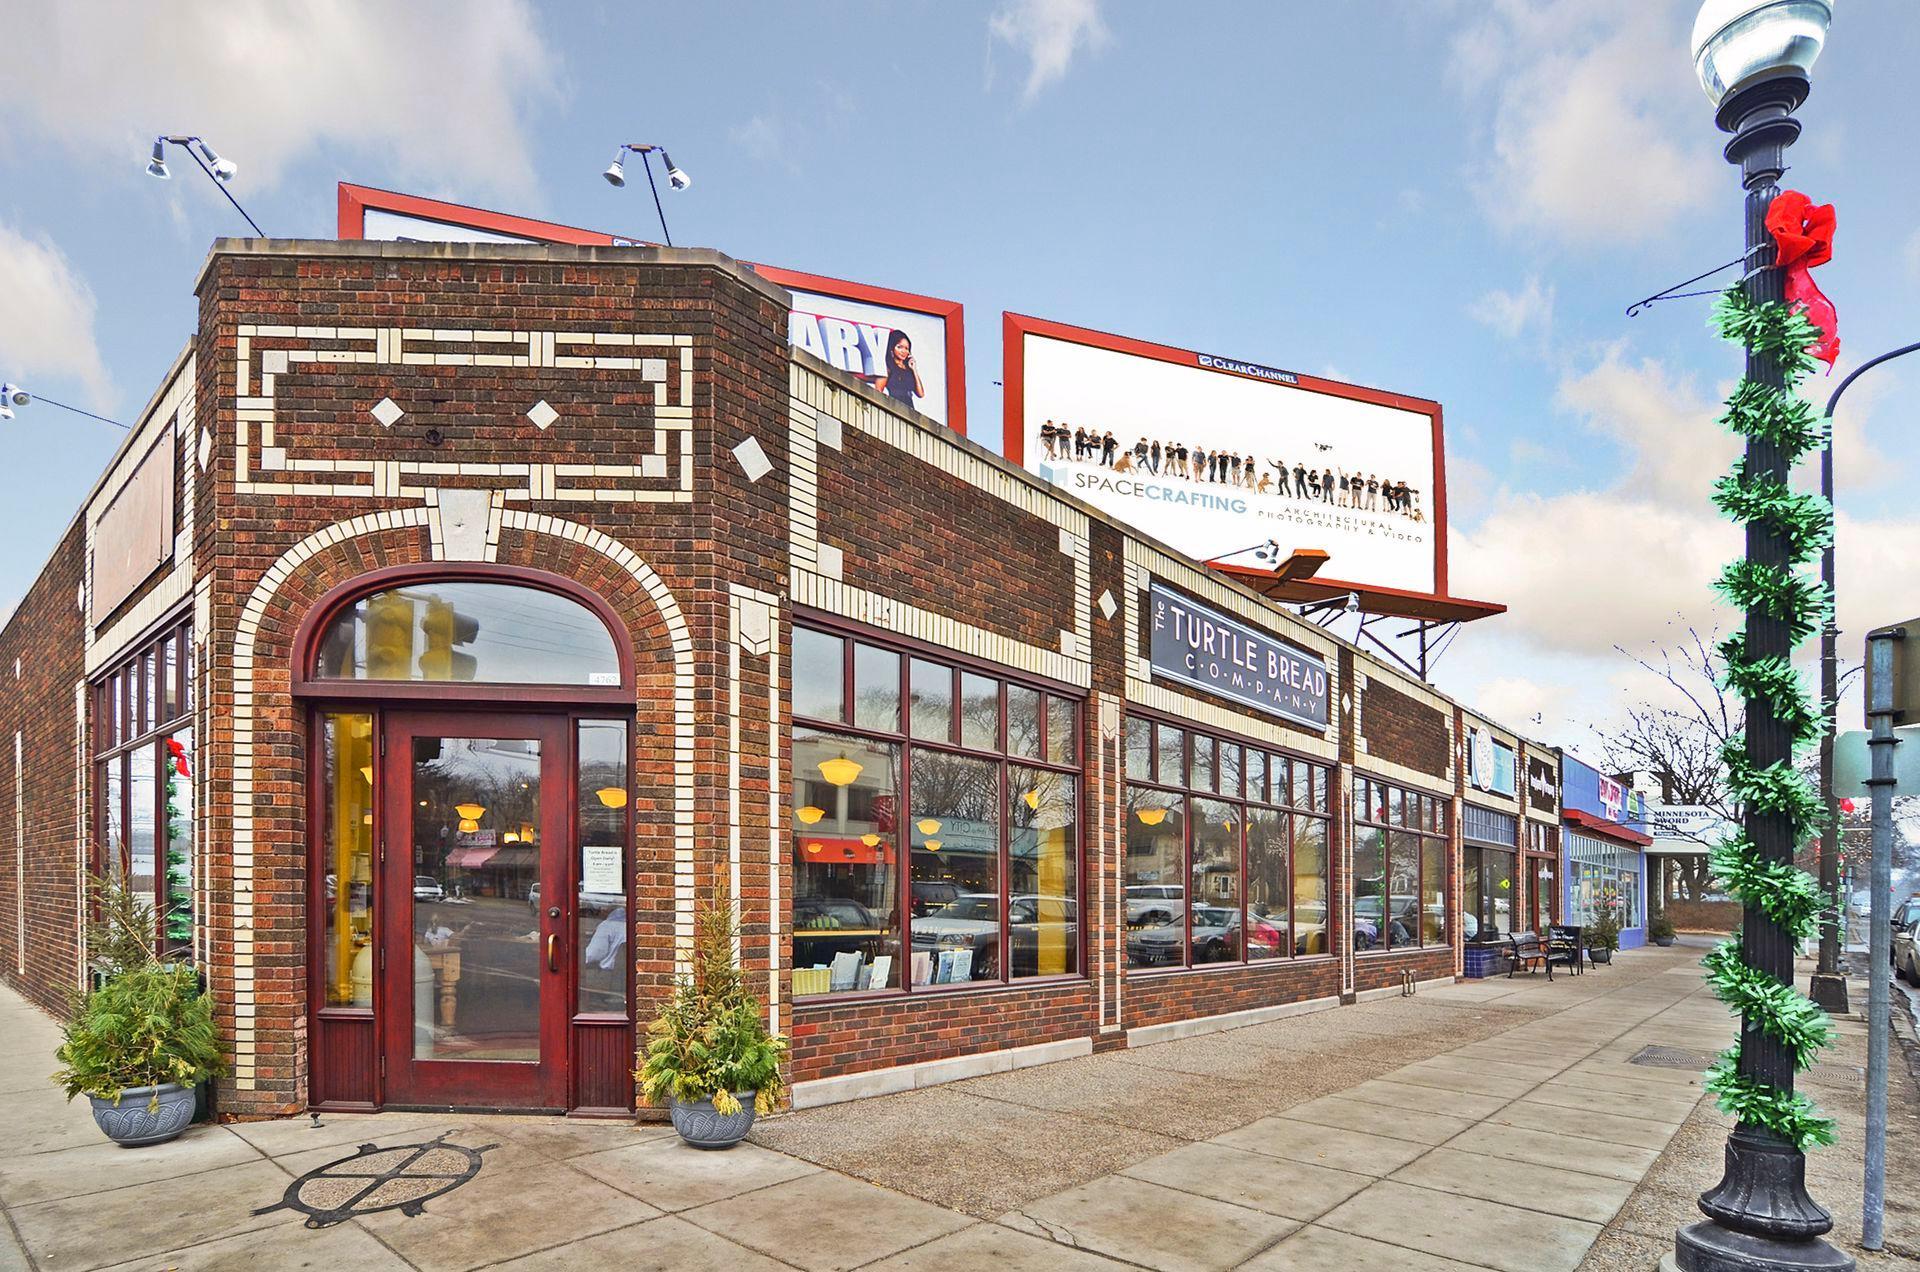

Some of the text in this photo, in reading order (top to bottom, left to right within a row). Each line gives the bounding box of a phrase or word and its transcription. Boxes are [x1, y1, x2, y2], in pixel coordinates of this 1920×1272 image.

[1075, 472, 1248, 514] SPACECRAFTING
[1258, 510, 1359, 532] PHOTOGRAPHY
[1383, 531, 1422, 543] VIDEO
[1284, 506, 1393, 531] ARCHITECTURAL
[1155, 600, 1165, 632] The
[1170, 606, 1325, 697] TURTLE BREAD
